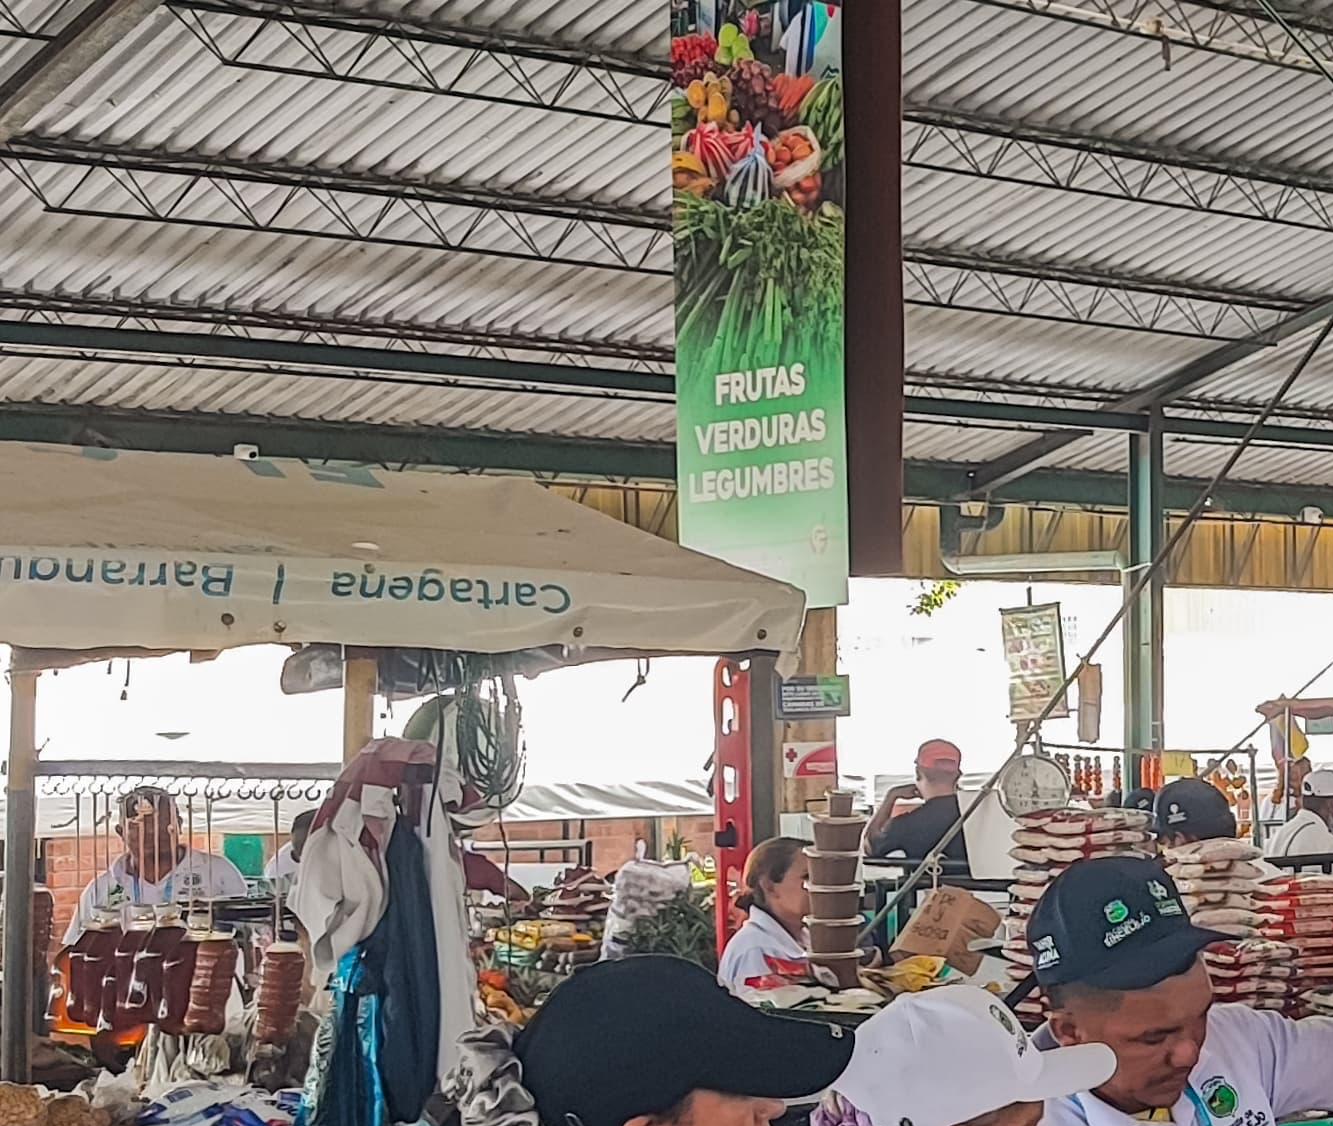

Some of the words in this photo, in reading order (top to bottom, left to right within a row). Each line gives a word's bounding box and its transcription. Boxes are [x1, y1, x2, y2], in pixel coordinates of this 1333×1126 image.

[715, 363, 805, 405] FRUTAS
[695, 408, 826, 455] VERDURAS
[689, 457, 834, 503] LEGUMBRES
[331, 568, 571, 614] Cartagena
